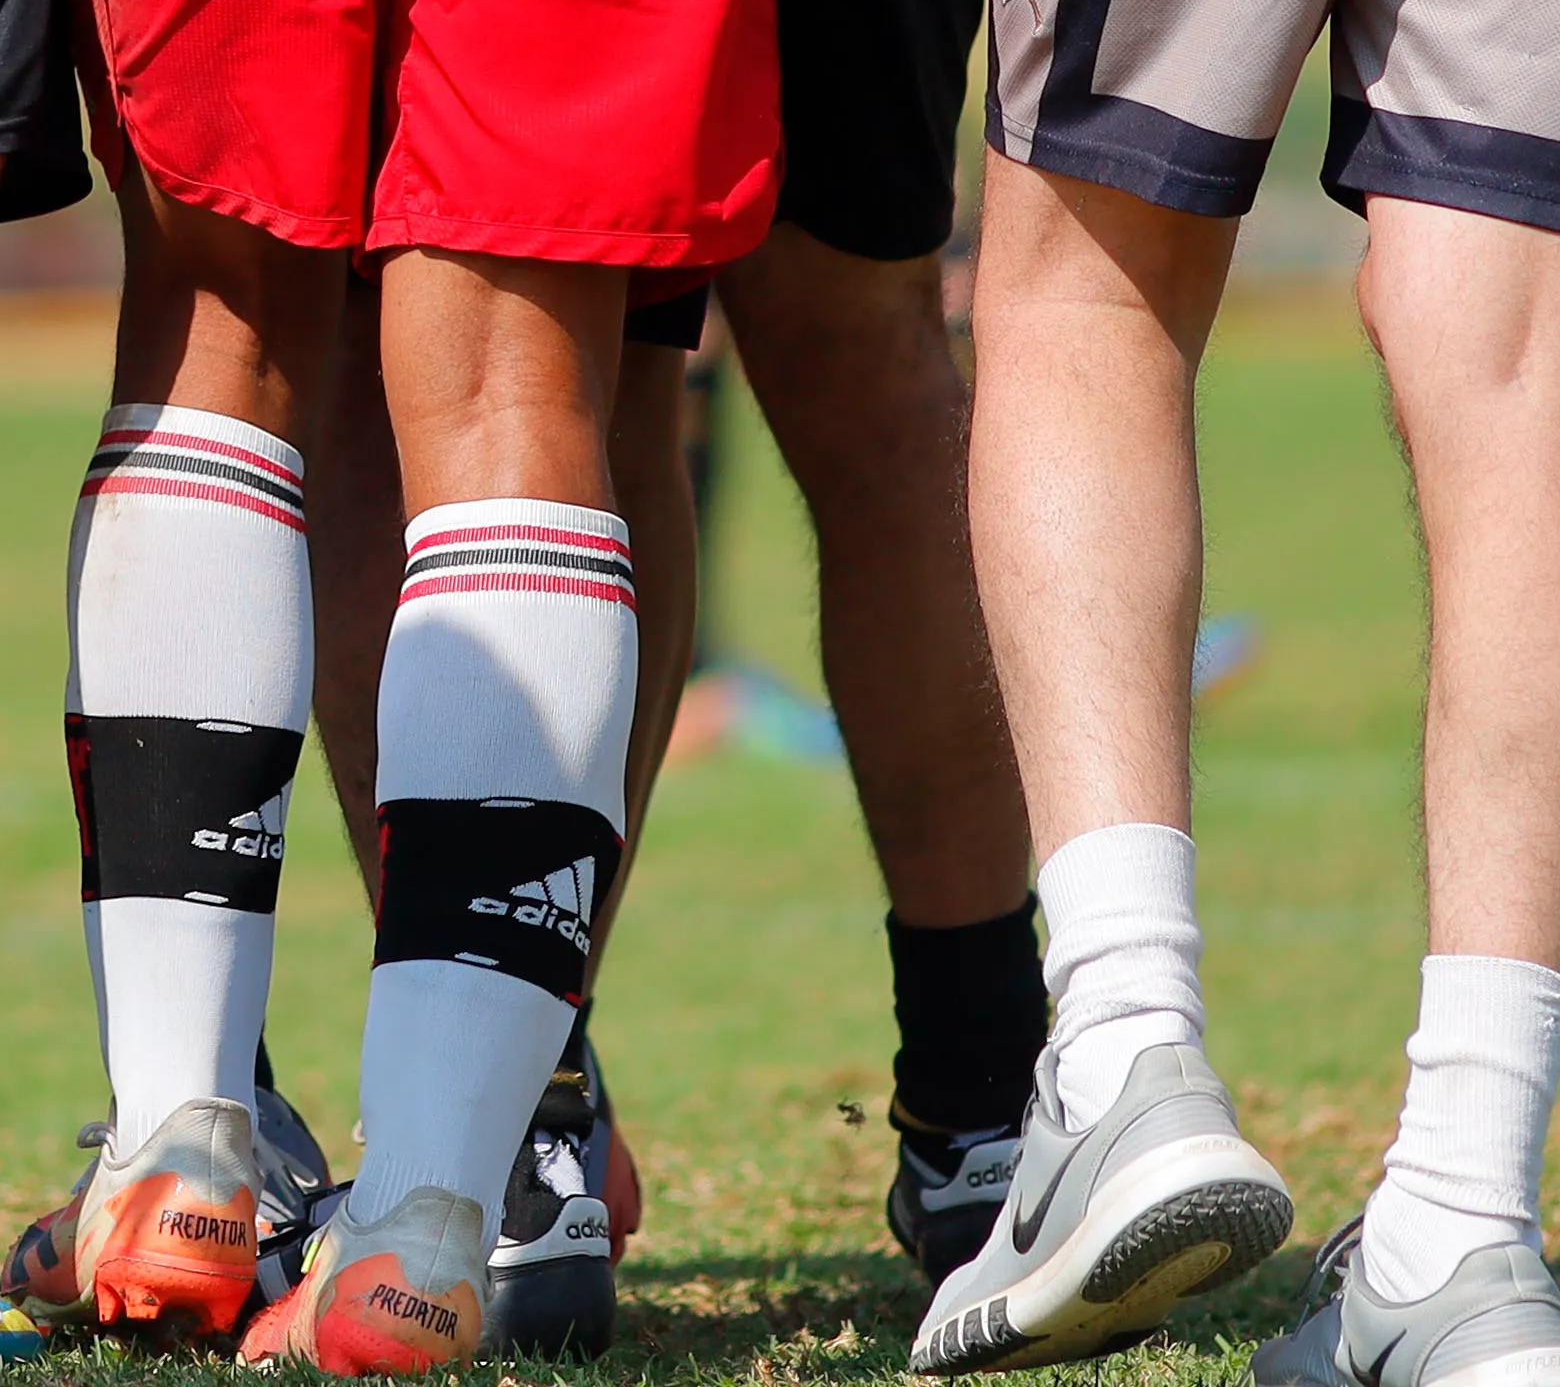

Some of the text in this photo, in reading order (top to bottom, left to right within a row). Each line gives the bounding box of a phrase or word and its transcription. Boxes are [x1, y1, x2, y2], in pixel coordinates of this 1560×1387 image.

[191, 829, 284, 859] adid
[468, 896, 591, 956] adidas
[159, 1210, 248, 1247] PREDATOR
[369, 1283, 458, 1341] PREDATOR
